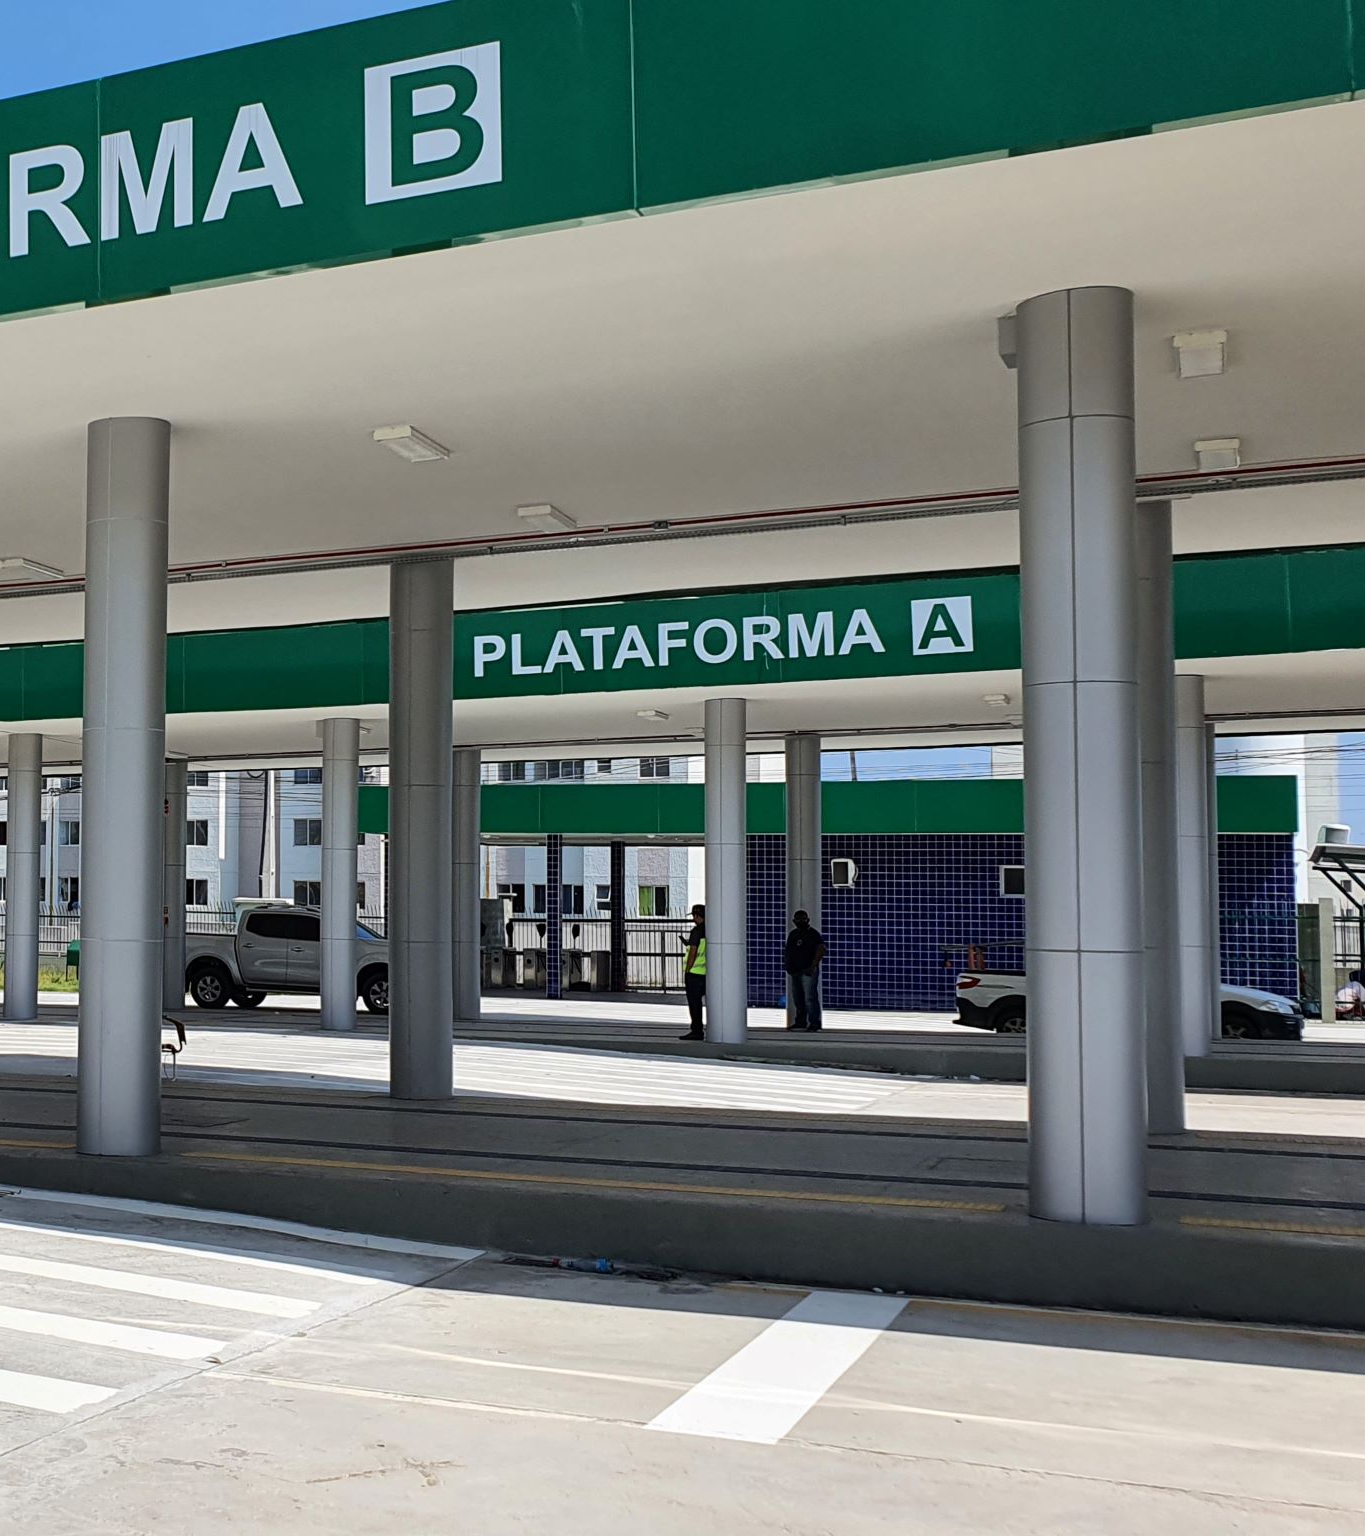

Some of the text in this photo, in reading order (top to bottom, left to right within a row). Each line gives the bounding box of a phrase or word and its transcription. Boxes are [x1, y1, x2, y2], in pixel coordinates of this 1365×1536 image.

[388, 62, 486, 188] B
[473, 602, 968, 677] PLATAFORMA A
